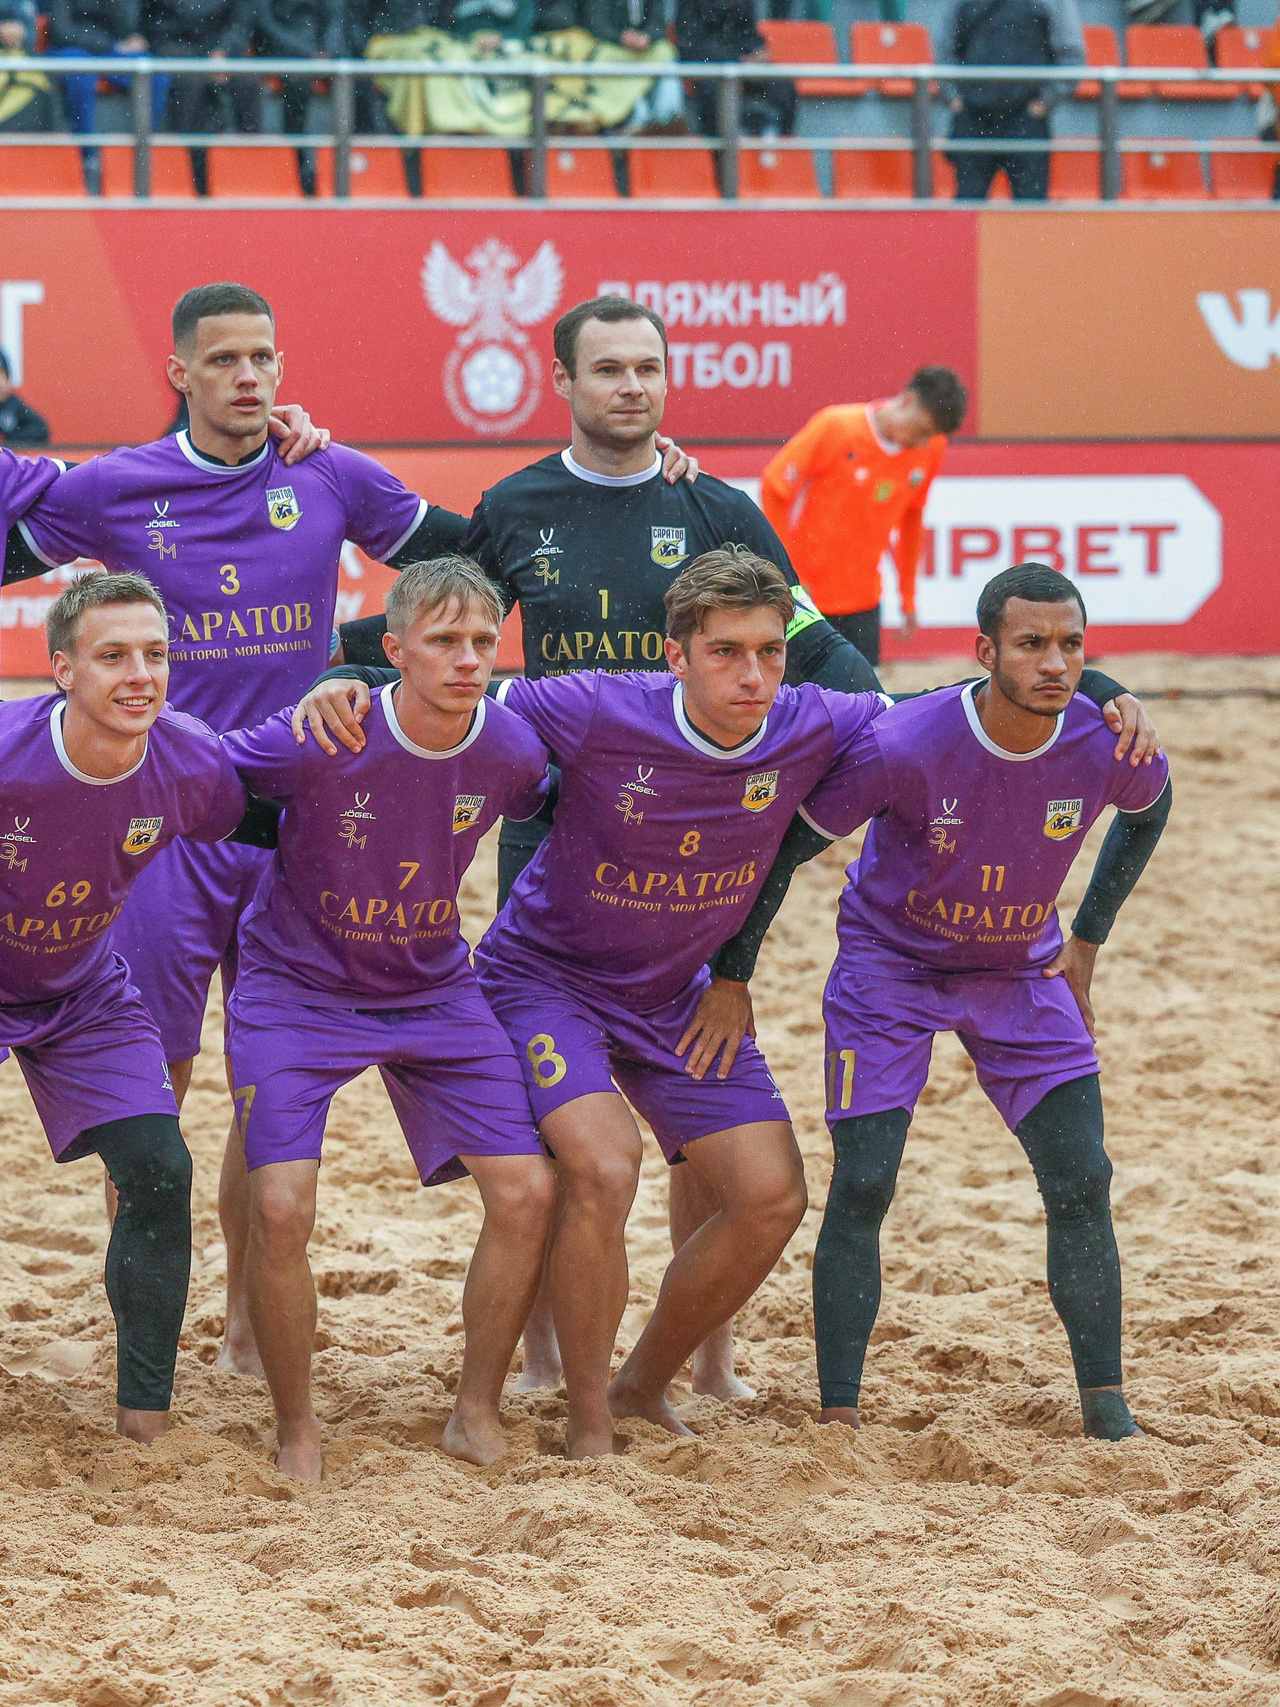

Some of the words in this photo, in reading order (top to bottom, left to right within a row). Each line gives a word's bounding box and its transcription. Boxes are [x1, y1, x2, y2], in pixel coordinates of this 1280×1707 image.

[666, 341, 792, 388] ТБОЛ
[267, 488, 292, 501] САРАТОВ
[145, 519, 180, 528] JÖGEL
[653, 529, 683, 540] САРАТОВ
[530, 547, 564, 557] JÖGEL
[219, 564, 241, 595] 3
[598, 589, 609, 620] 1
[190, 648, 228, 661] ГОРОД
[235, 644, 260, 657] МОЯ
[541, 631, 665, 661] САРАТО
[747, 772, 777, 786] САРАТОВ
[621, 782, 658, 796] JÖGEL
[339, 810, 376, 820] JÖGEL
[1048, 801, 1081, 812] САРАТОВ
[130, 818, 161, 830] САРАТОВ
[929, 817, 964, 825] JÖGEL
[0, 832, 37, 843] JÖGEL
[679, 830, 701, 856] 8
[399, 861, 421, 890] 7
[595, 861, 756, 897] САРАТОВ
[981, 865, 1005, 892] 11
[45, 880, 92, 908] 69
[590, 890, 618, 904] МОЙ
[621, 898, 661, 912] ГОРОД
[669, 903, 697, 912] МОЯ
[320, 890, 456, 928] САРАТО
[345, 930, 383, 943] ГОРОД
[976, 933, 1002, 943] МОЯ
[526, 1033, 567, 1088] 8
[828, 1049, 855, 1112] 11
